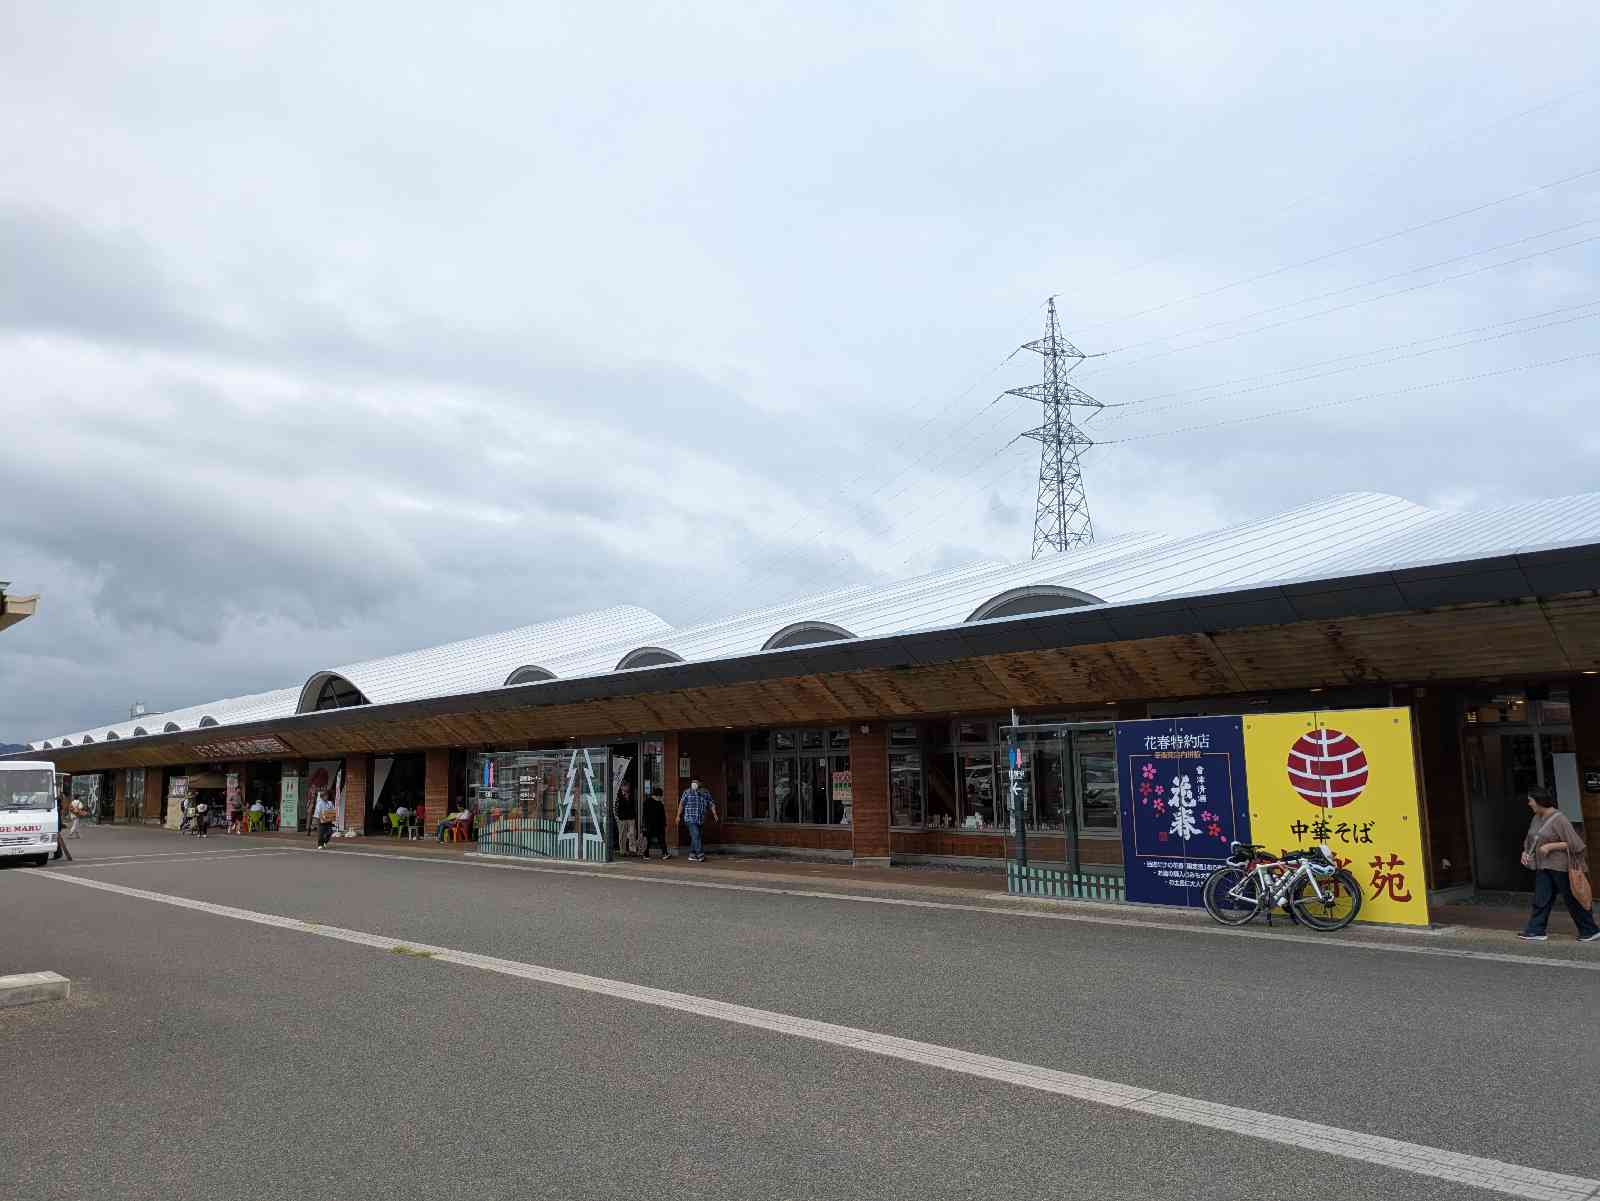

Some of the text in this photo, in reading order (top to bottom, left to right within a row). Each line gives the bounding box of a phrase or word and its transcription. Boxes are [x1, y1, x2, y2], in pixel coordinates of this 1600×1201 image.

[1144, 733, 1211, 750] 花春特約店
[1168, 774, 1203, 841] 花春
[1291, 819, 1375, 844] 中華そば
